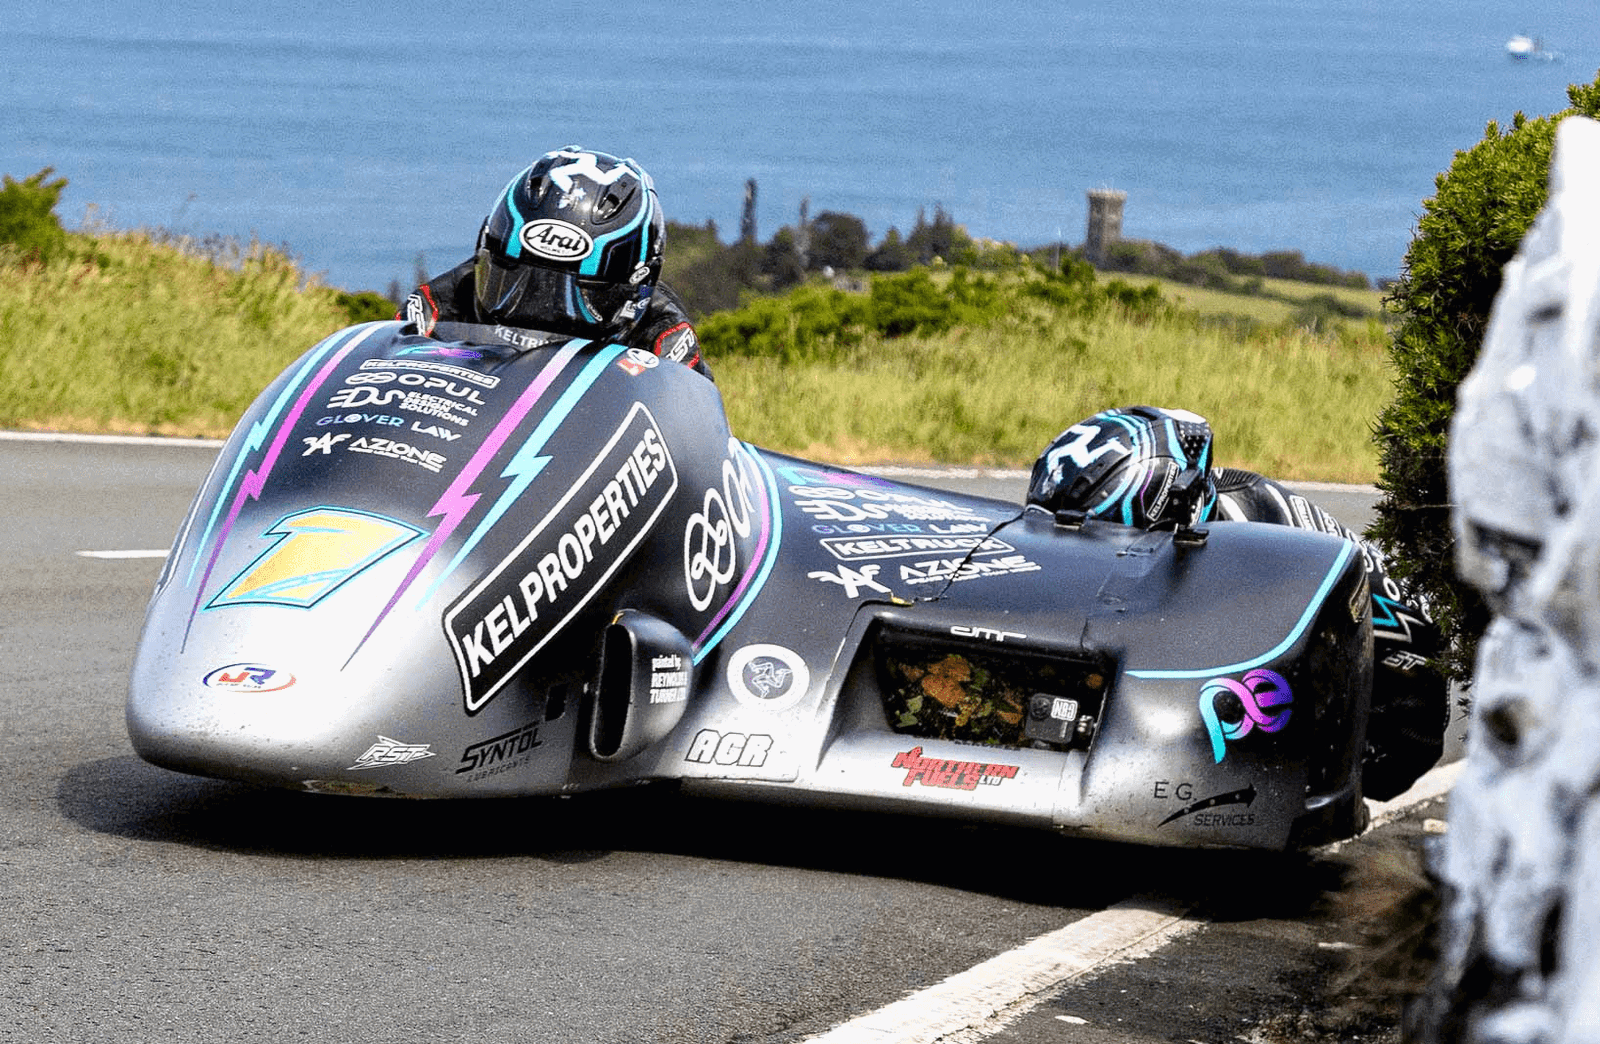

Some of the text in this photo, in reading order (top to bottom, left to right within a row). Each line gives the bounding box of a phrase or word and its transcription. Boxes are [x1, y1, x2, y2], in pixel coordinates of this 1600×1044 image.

[526, 225, 583, 252] Arai
[495, 324, 549, 349] KELTR
[398, 373, 486, 405] OPUL
[399, 402, 470, 426] SOLUTIONS
[407, 391, 478, 416] ELECTRICAL
[316, 413, 462, 441] GLOVER LAW
[349, 437, 447, 468] AZIONE
[812, 523, 922, 535] GLOVER
[462, 428, 667, 678] KELPROPERTIES
[834, 535, 1002, 556] KELTRUCK
[900, 555, 1037, 581] AZIONE
[356, 743, 431, 764] RST
[455, 721, 543, 774] SYNTOL
[1194, 813, 1255, 827] SERVICES
